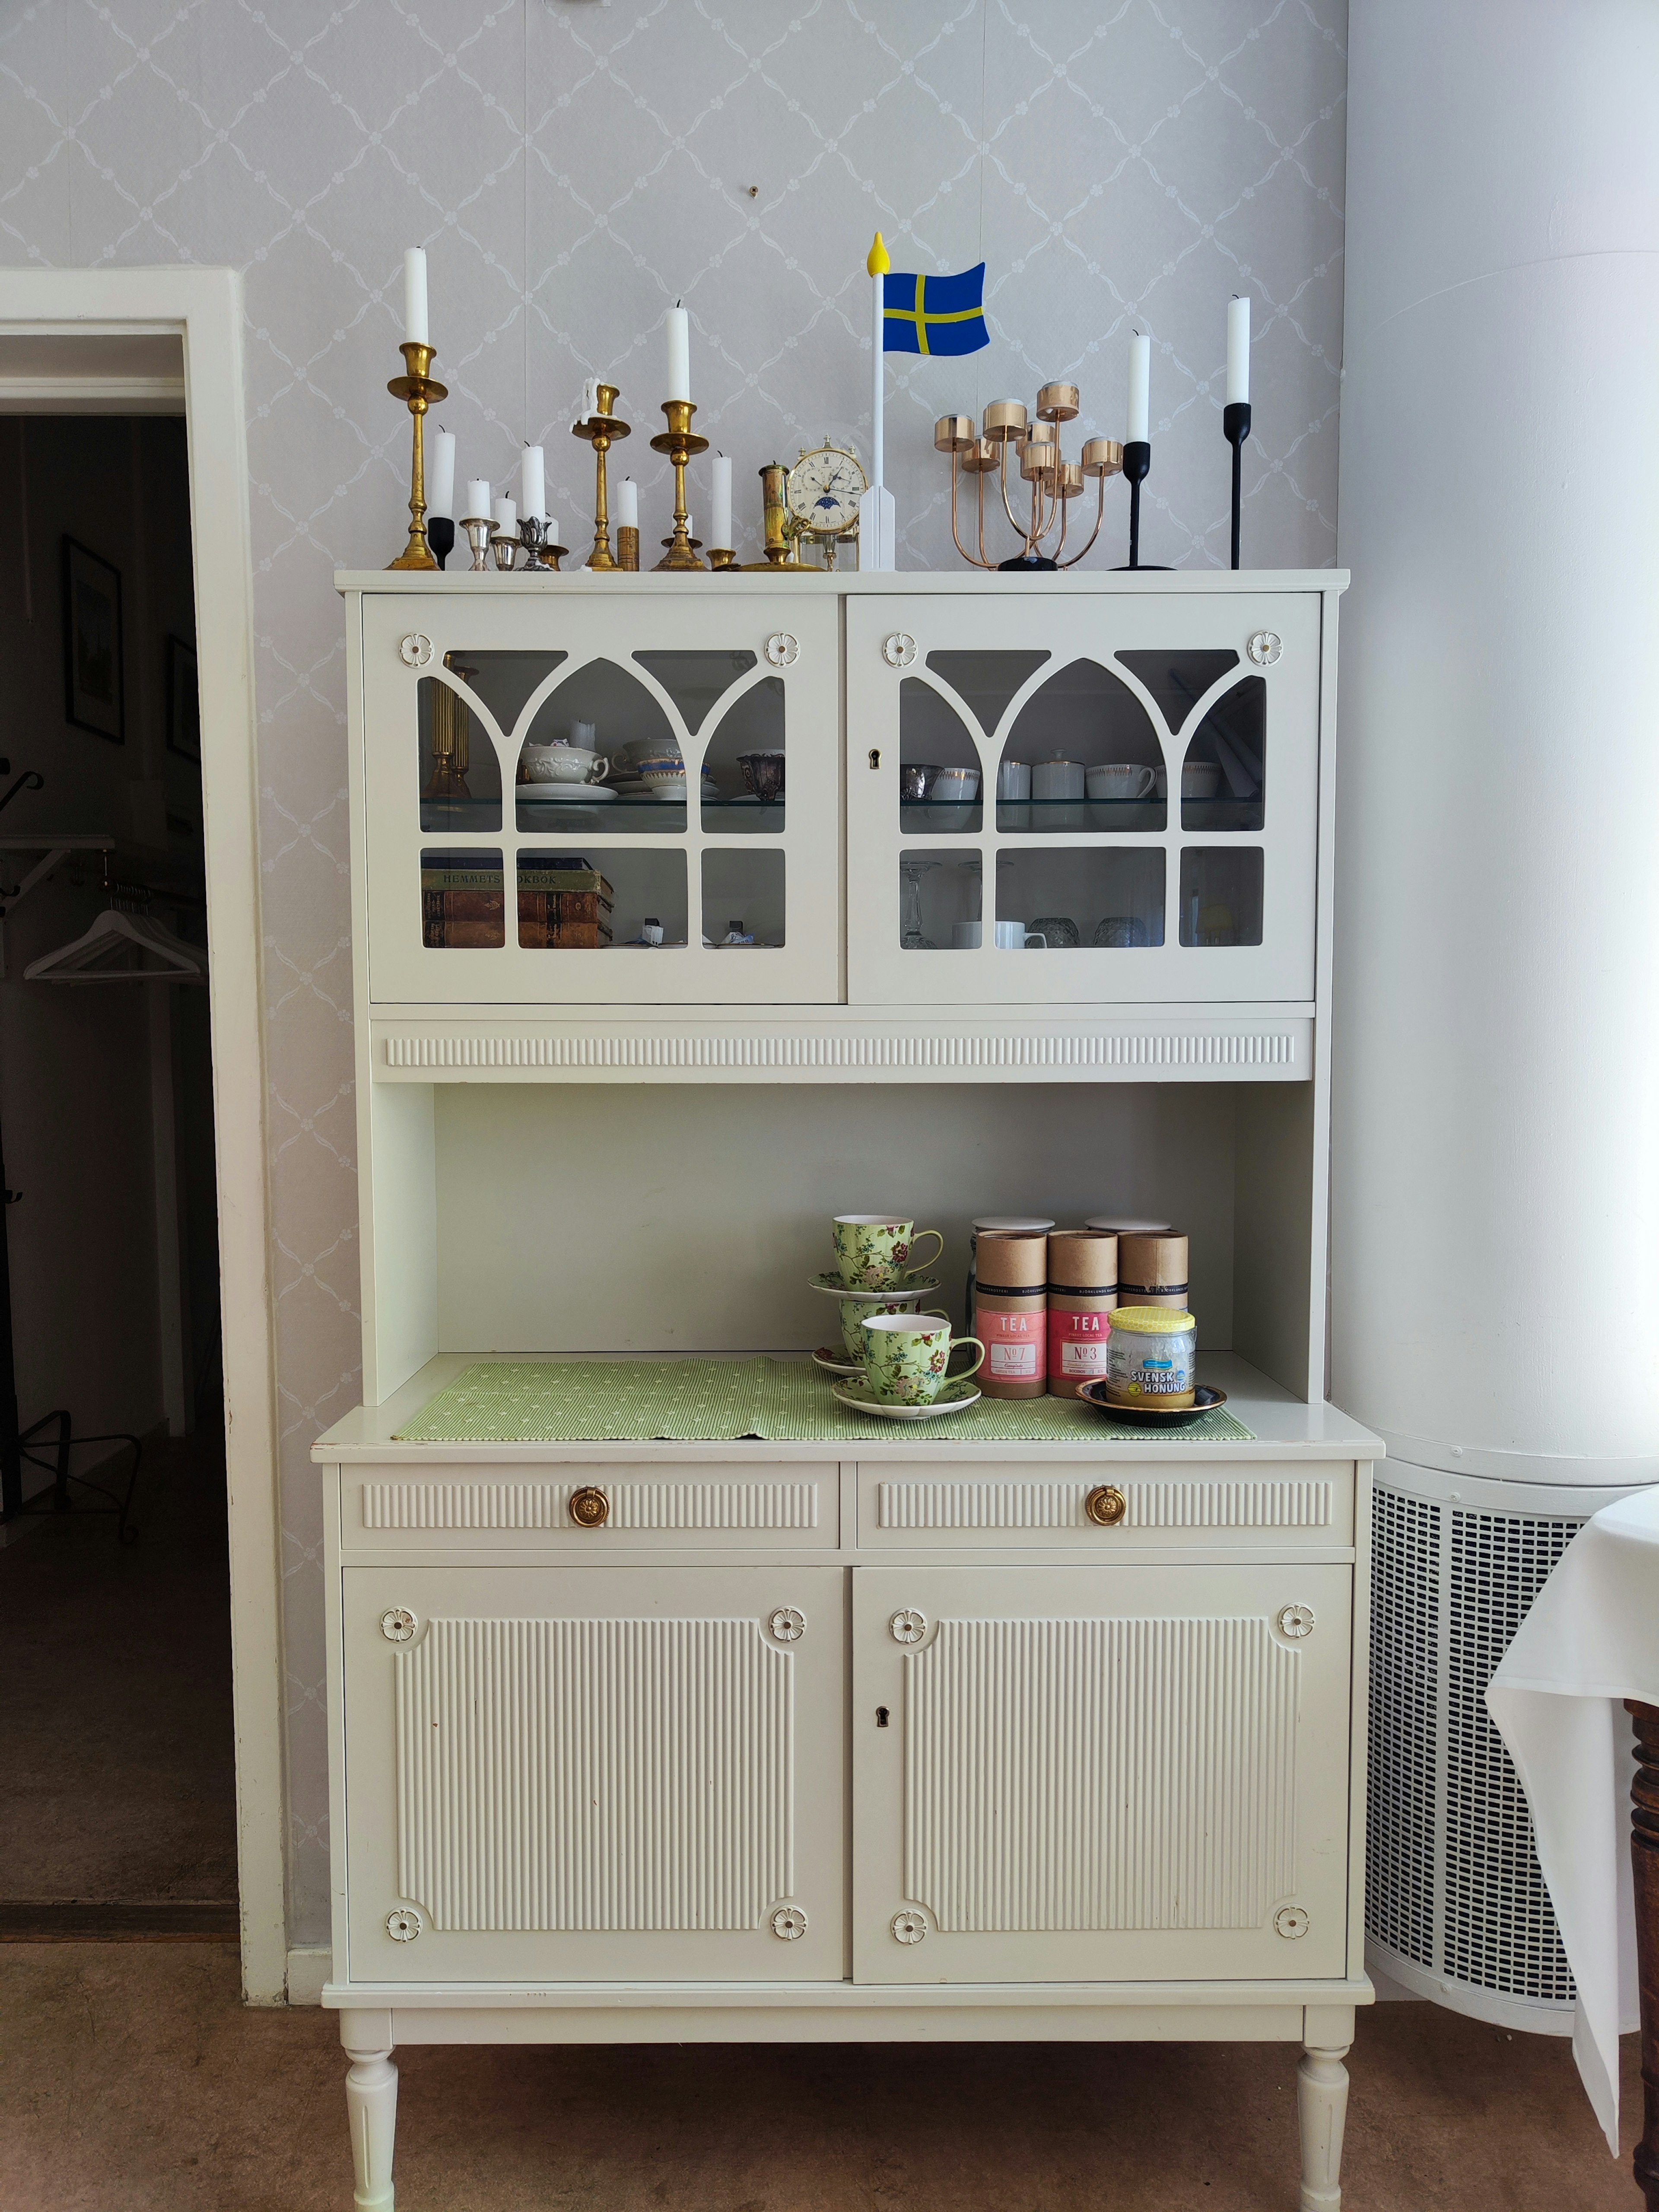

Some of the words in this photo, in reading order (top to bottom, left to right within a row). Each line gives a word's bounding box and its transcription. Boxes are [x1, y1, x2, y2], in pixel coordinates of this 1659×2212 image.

[444, 875, 500, 883] HEMMETS
[517, 875, 556, 884] OKBOK
[1001, 1317, 1027, 1331] TEA
[1072, 1316, 1100, 1331] TEA
[1131, 1370, 1174, 1382] SVENSK
[1144, 1382, 1186, 1393] HONUNG
